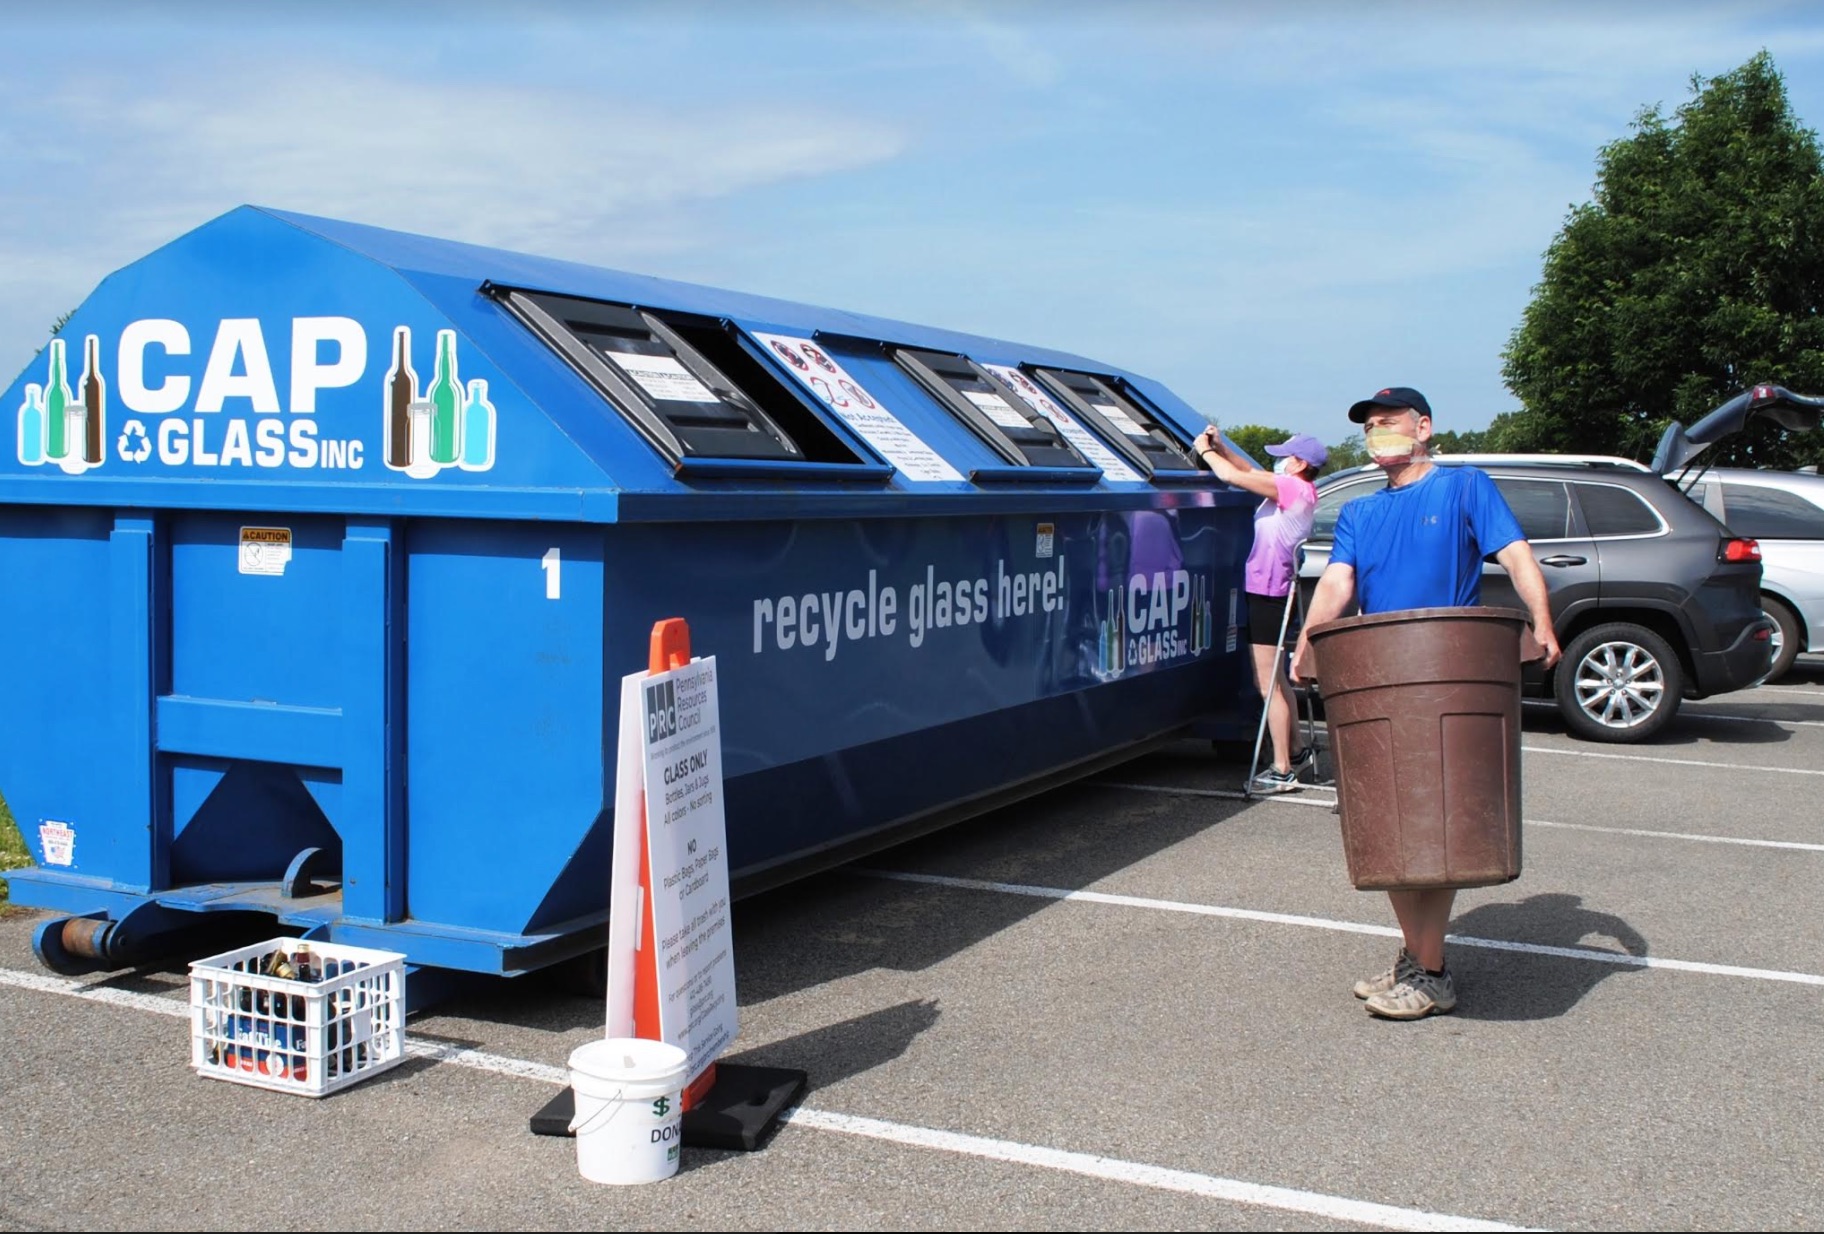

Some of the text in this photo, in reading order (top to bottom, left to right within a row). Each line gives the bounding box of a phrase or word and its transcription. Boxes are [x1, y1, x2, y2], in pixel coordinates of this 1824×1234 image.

[117, 316, 368, 414] CAP
[157, 418, 364, 470] GLASS INC
[249, 531, 288, 541] CAUTION
[542, 548, 560, 599] 1
[753, 555, 1065, 662] recycle glass here!
[1128, 569, 1190, 634] CAP
[1138, 629, 1178, 665] GLASS
[676, 667, 713, 693] Pennsylvania
[677, 690, 707, 712] Resources
[649, 706, 676, 739] PRC
[678, 707, 702, 732] Council
[664, 748, 708, 785] GLASS ONLY
[685, 783, 695, 796] Jars
[699, 774, 710, 788] Jugs
[672, 806, 687, 822] colors
[690, 800, 696, 812] No
[697, 791, 712, 809] sorting
[687, 838, 697, 856] NO
[663, 870, 681, 891] Plastic
[695, 854, 708, 869] Paper
[708, 846, 719, 861] Bags
[679, 872, 709, 900] or Cardboard
[662, 933, 679, 952] Please
[679, 925, 690, 940] take
[666, 952, 681, 970] when
[681, 939, 699, 959] leaving
[699, 932, 707, 945] the
